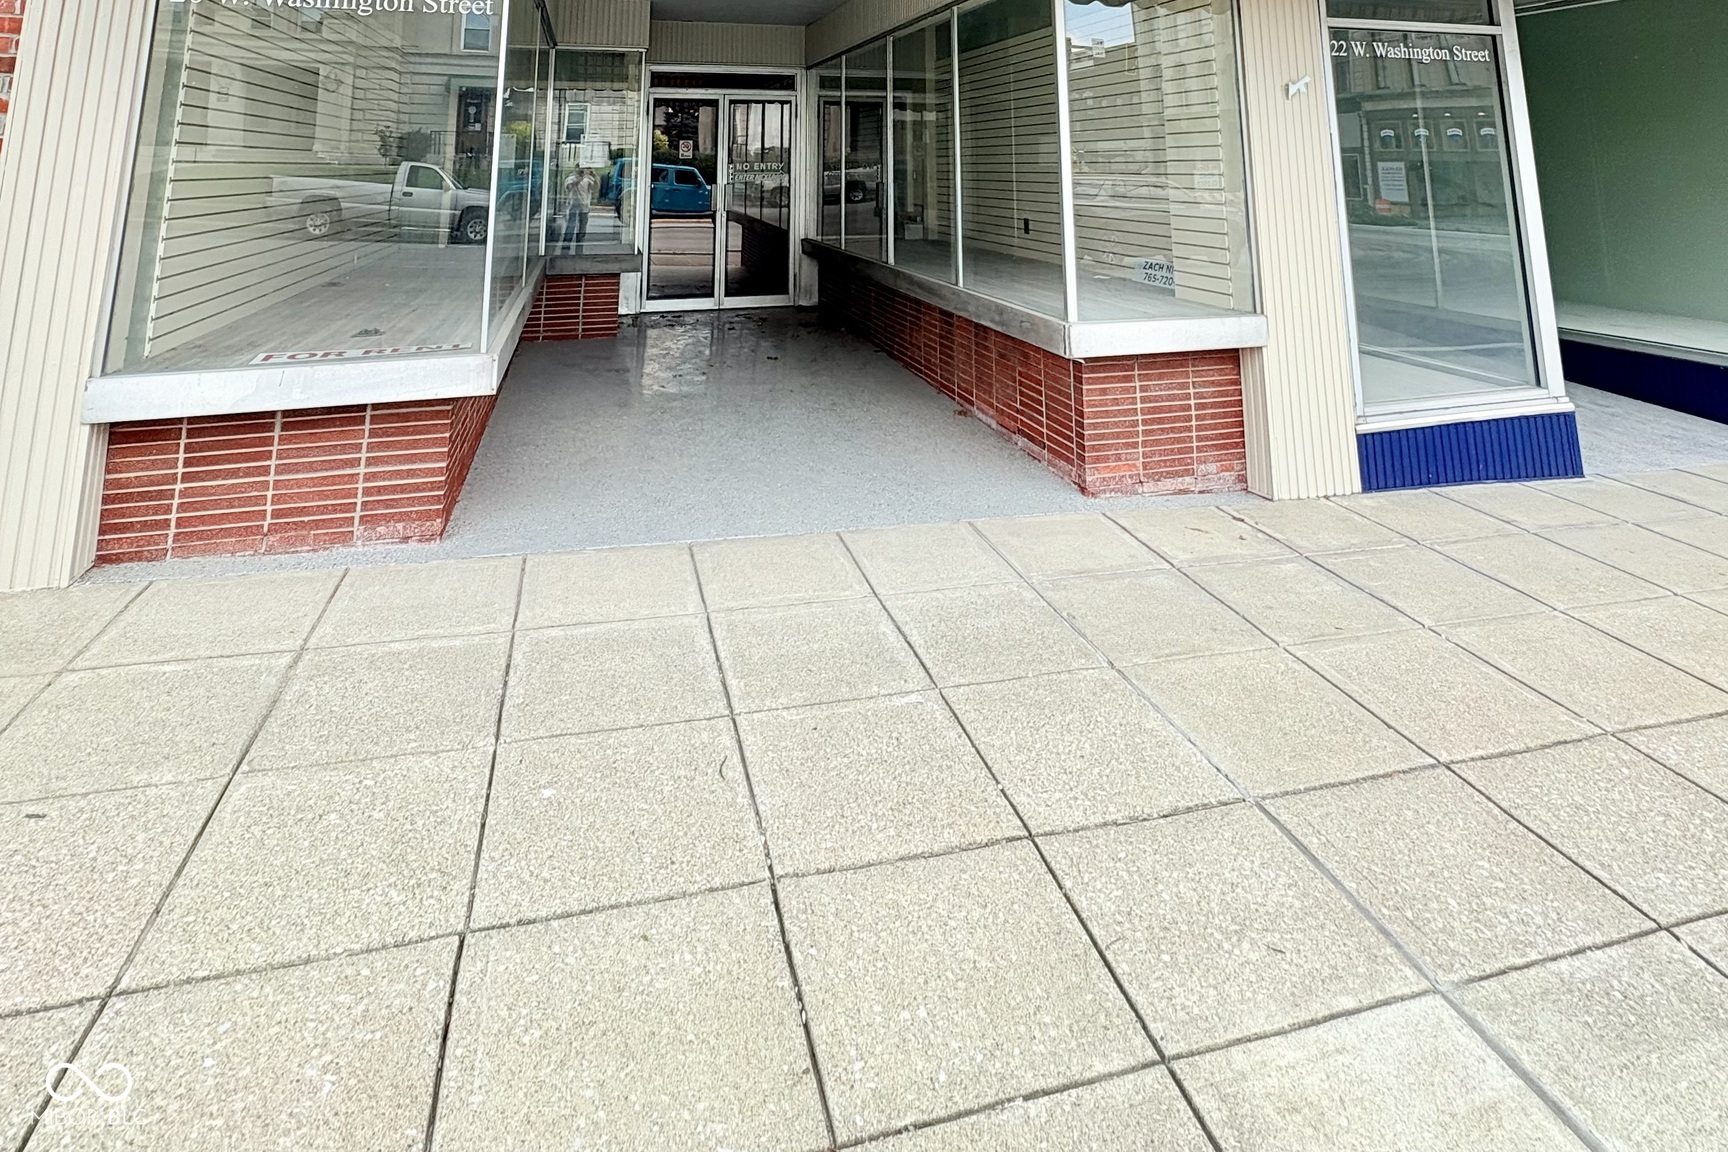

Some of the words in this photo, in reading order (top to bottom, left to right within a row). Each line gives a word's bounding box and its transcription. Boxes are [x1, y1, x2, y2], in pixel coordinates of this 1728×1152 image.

[1330, 40, 1348, 57] 22
[1350, 41, 1370, 58] W.
[1372, 42, 1450, 64] Washington
[1452, 45, 1491, 62] Street
[736, 162, 750, 171] NO
[753, 162, 785, 171] ENTRY
[1142, 260, 1165, 273] ZACH
[259, 350, 348, 363] FOR
